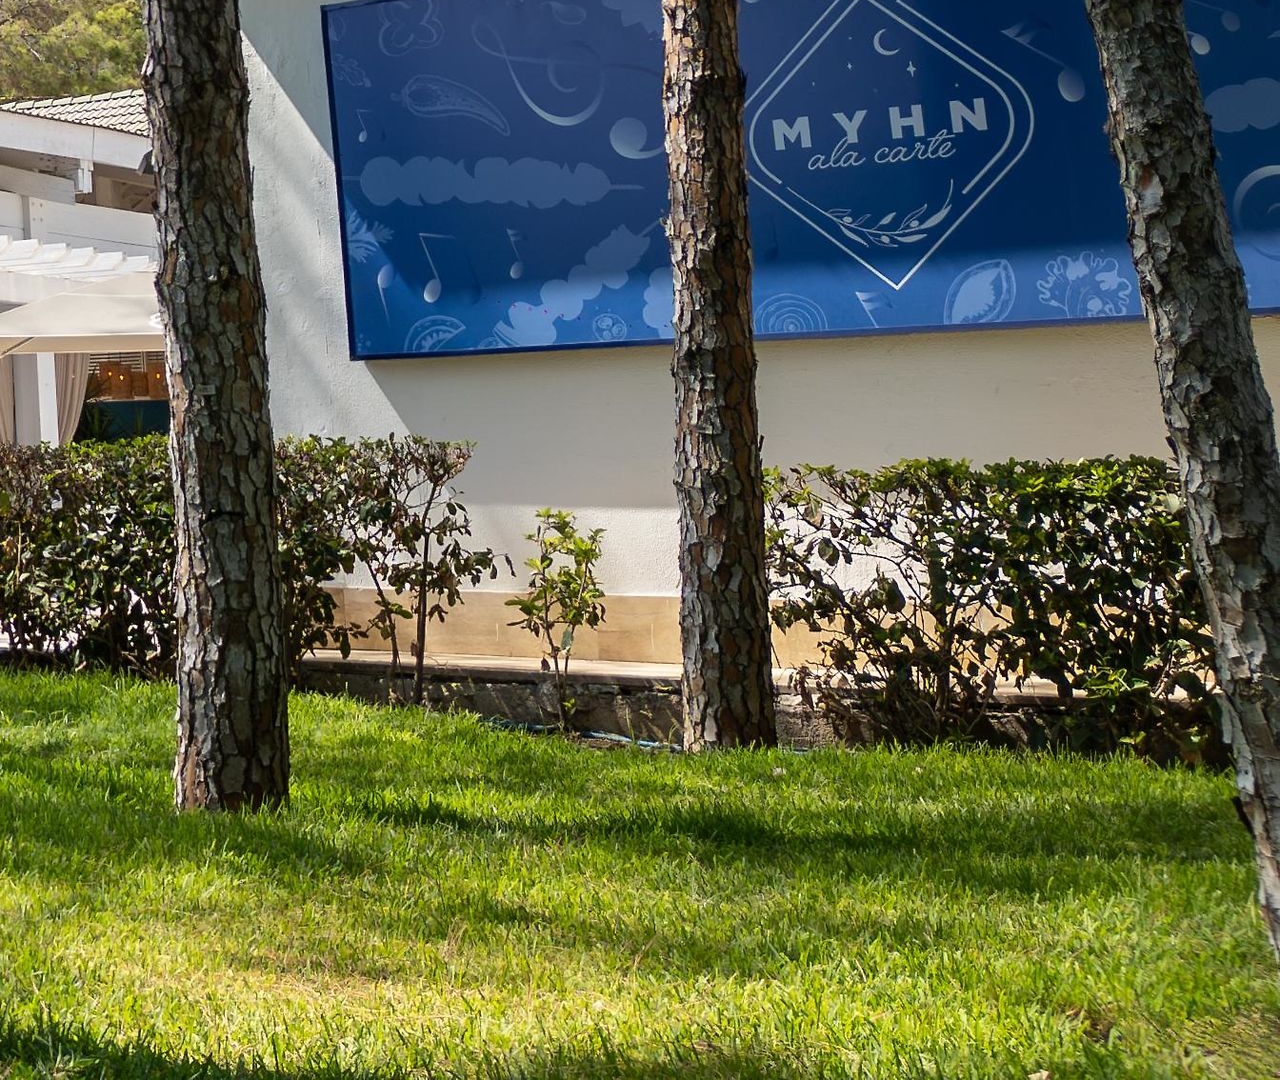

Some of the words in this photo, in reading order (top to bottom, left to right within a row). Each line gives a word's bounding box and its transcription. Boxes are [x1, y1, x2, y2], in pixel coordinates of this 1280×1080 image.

[772, 97, 988, 151] MYHN
[808, 136, 866, 170] ala
[873, 129, 957, 164] carte
